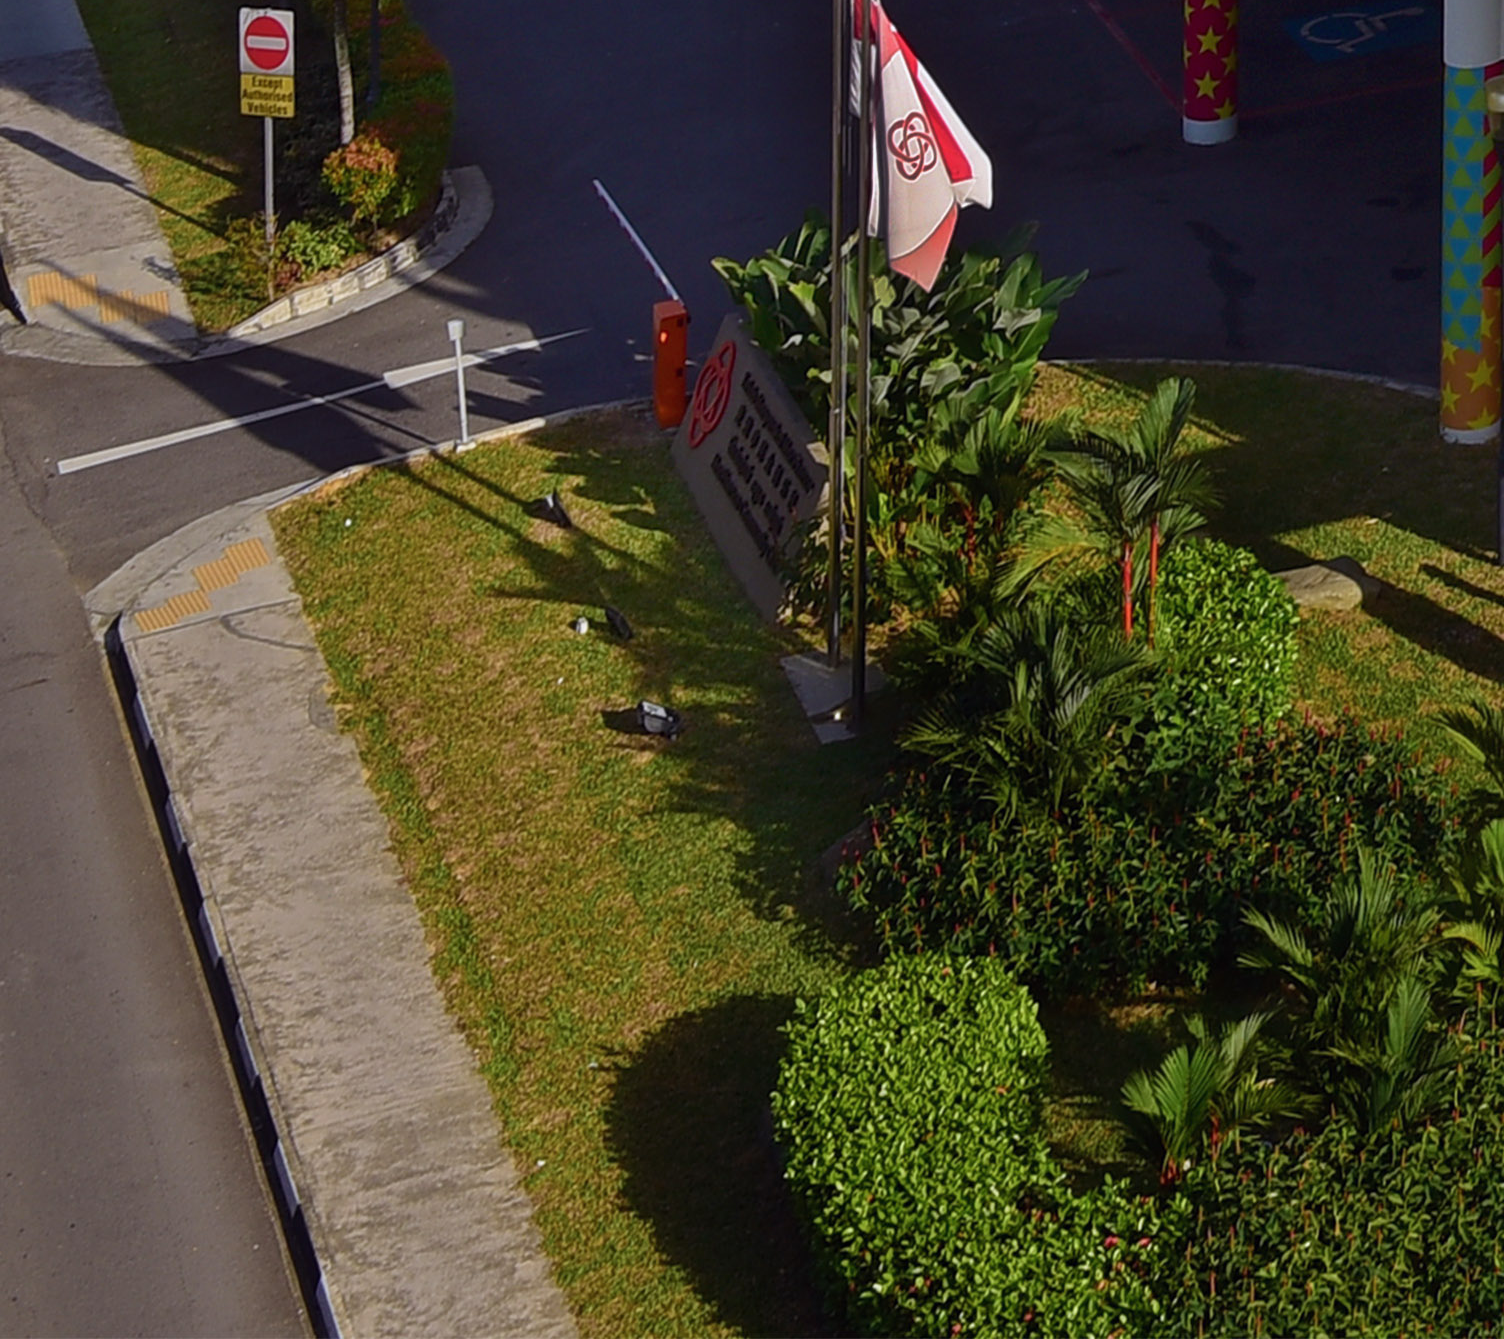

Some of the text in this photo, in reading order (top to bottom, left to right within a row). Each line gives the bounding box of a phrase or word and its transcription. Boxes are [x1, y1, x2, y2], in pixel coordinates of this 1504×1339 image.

[251, 76, 284, 92] Except
[242, 89, 293, 104] Authorised
[247, 102, 288, 115] Vehicles
